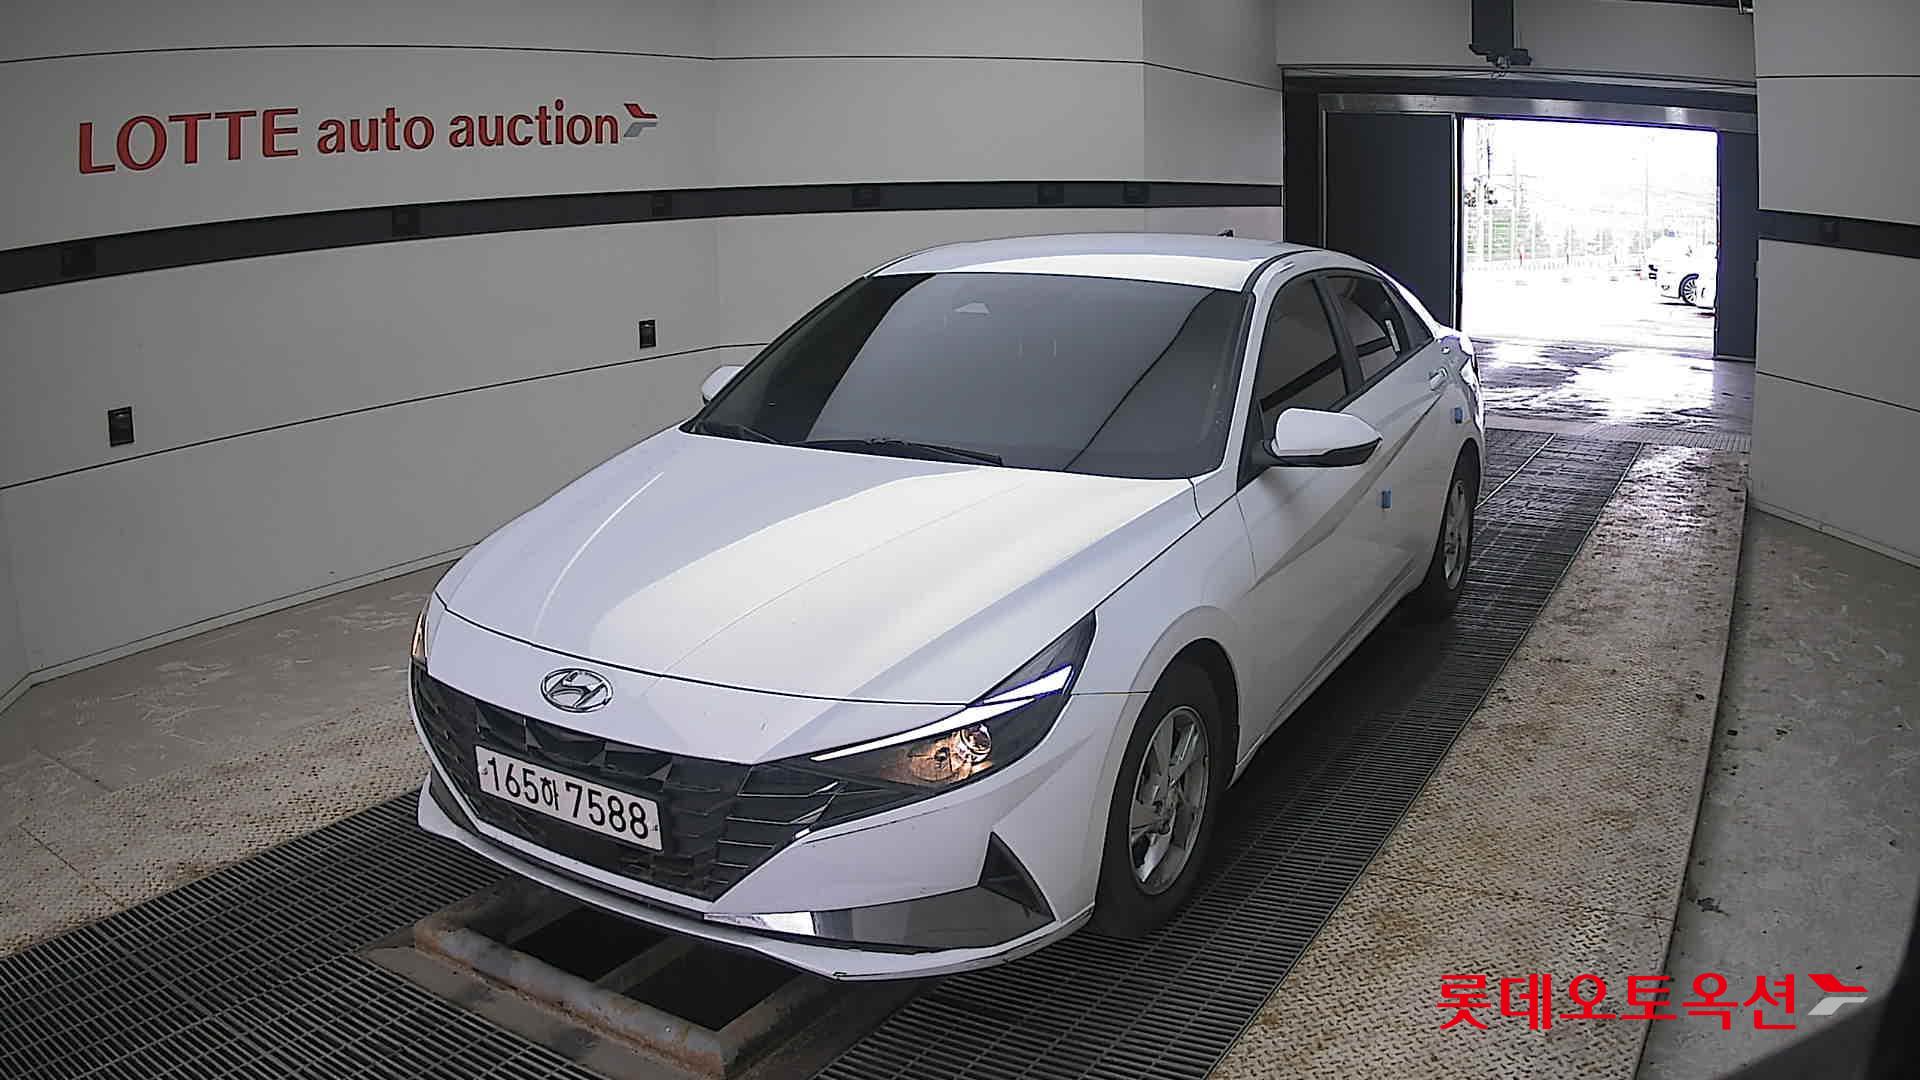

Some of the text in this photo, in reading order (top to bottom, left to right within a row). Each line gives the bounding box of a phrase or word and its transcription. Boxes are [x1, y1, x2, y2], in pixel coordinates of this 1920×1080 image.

[79, 99, 619, 174] LOTTE auto auction
